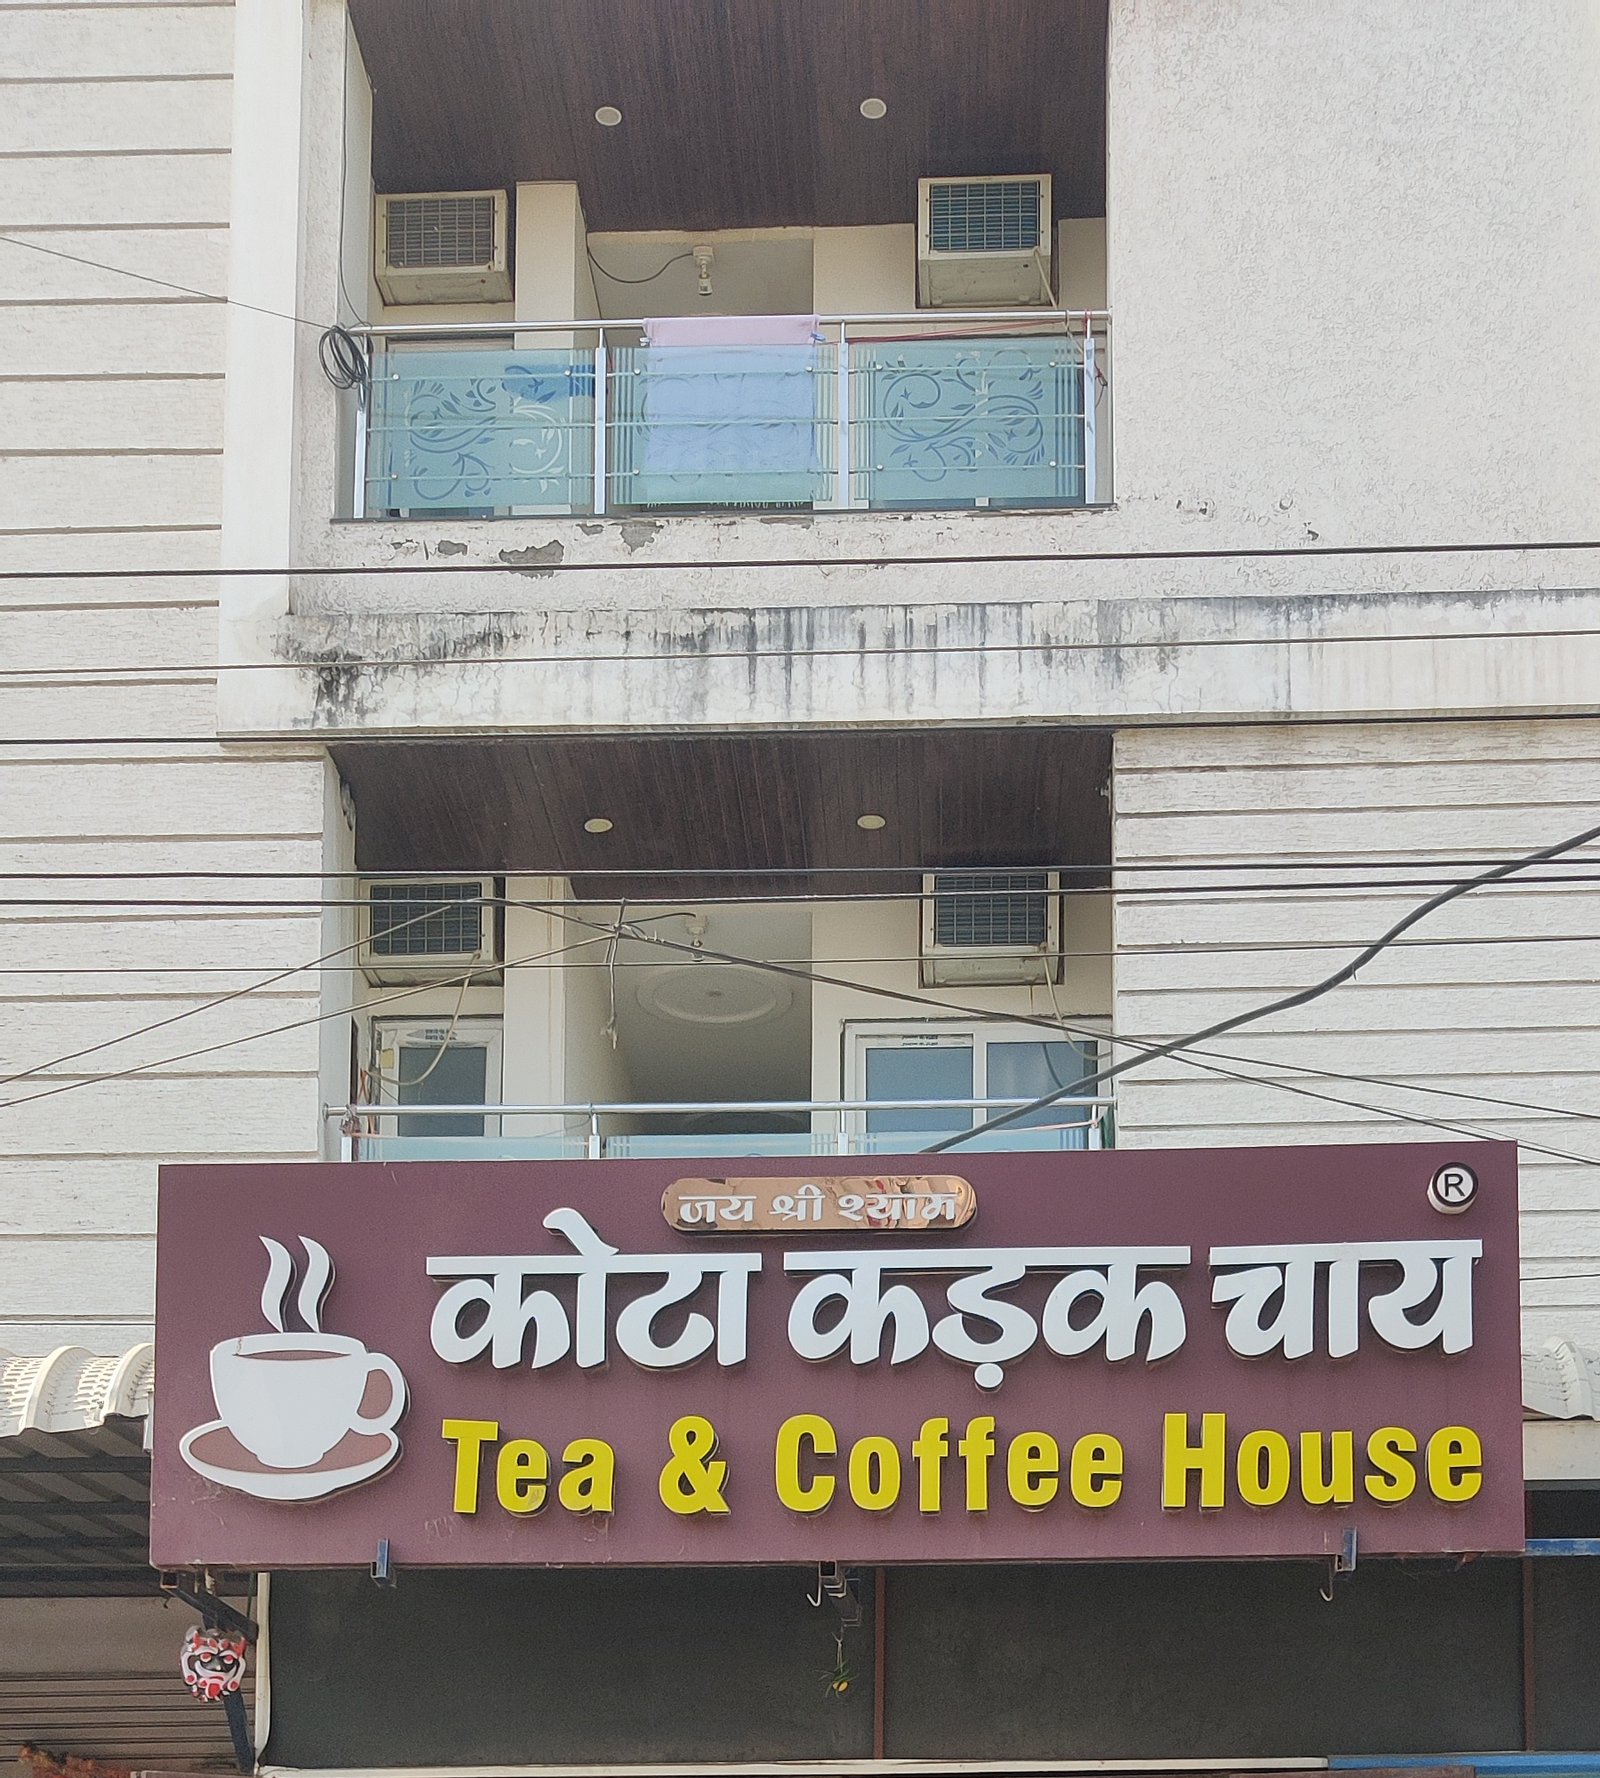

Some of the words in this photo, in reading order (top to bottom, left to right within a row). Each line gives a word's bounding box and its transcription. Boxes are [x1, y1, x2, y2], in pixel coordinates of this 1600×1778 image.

[678, 1195, 757, 1223] जय
[769, 1184, 826, 1222] श्री
[838, 1193, 959, 1221] श्याम
[426, 1207, 763, 1369] कोटा
[783, 1245, 1192, 1391] कड़क
[1209, 1239, 1484, 1360] चाय
[441, 1418, 615, 1514] Tea
[659, 1415, 731, 1514] &
[776, 1414, 1124, 1513] Coffee
[1163, 1413, 1484, 1508] House
